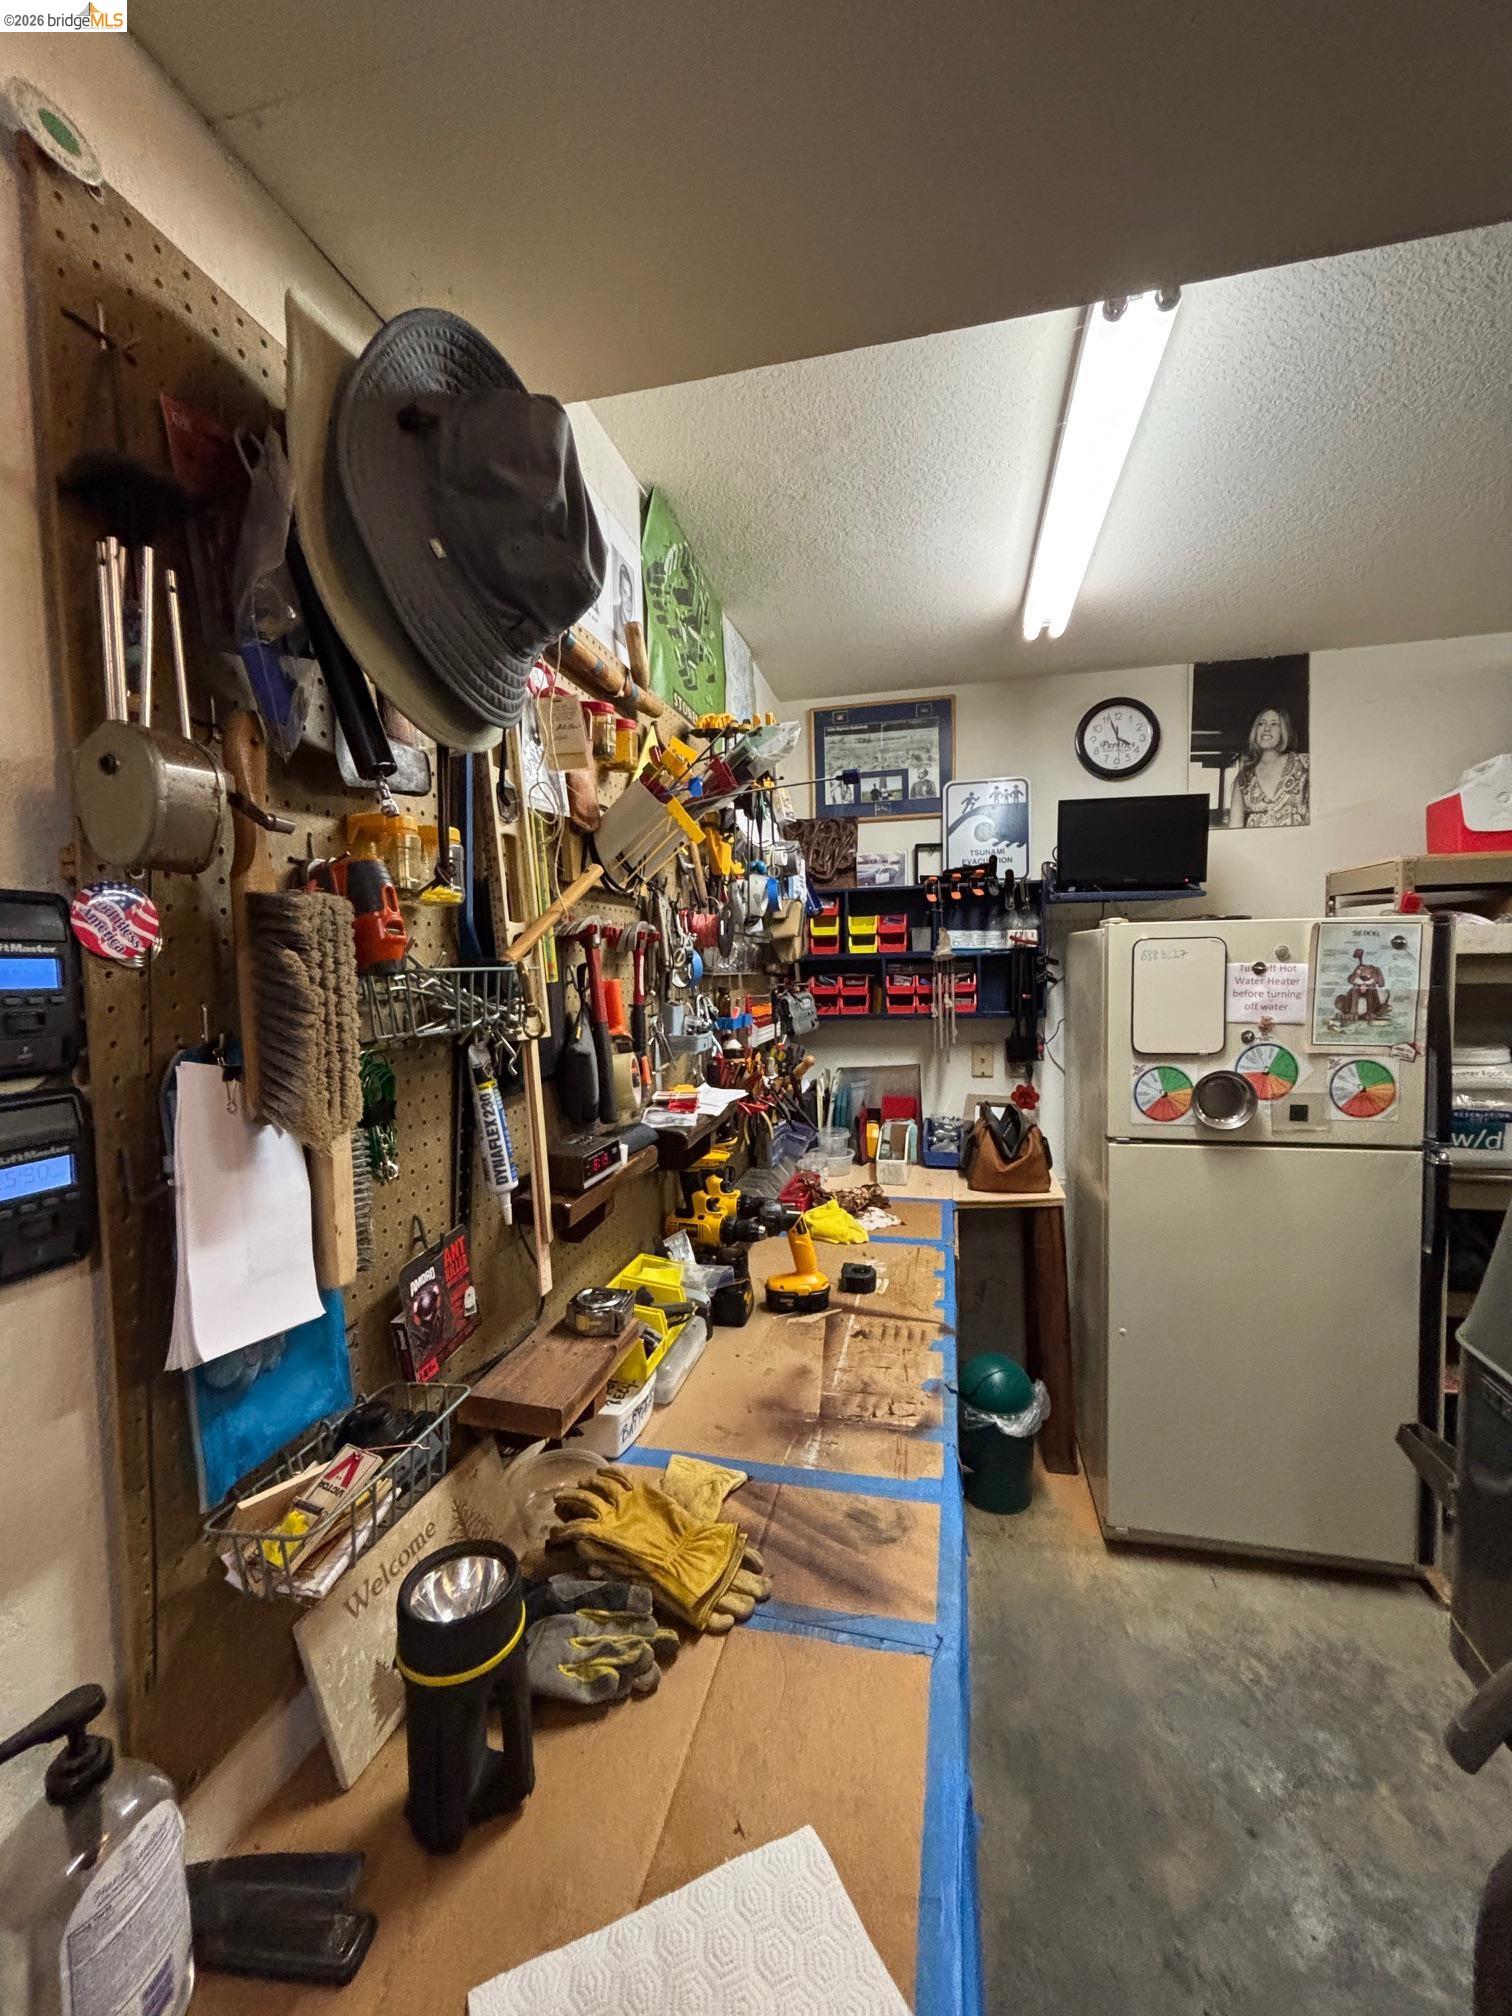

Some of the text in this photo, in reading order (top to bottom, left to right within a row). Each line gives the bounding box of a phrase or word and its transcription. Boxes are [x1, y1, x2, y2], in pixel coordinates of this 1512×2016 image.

[961, 857, 1013, 865] EVACUION
[969, 848, 1005, 857] TSUNAMI
[82, 907, 125, 953] America
[116, 917, 140, 949] Bless
[1279, 964, 1297, 973] Hot
[1235, 976, 1301, 985] Water Heater
[1232, 988, 1303, 1000] before turning
[1244, 1002, 1288, 1011] off water
[480, 1092, 496, 1119] 230
[1451, 1128, 1502, 1151] w/d
[484, 1118, 509, 1187] DYNAFLEX
[409, 1265, 436, 1298] AMDRO
[317, 1479, 346, 1498] VICTOR
[342, 1520, 437, 1620] Welcome
